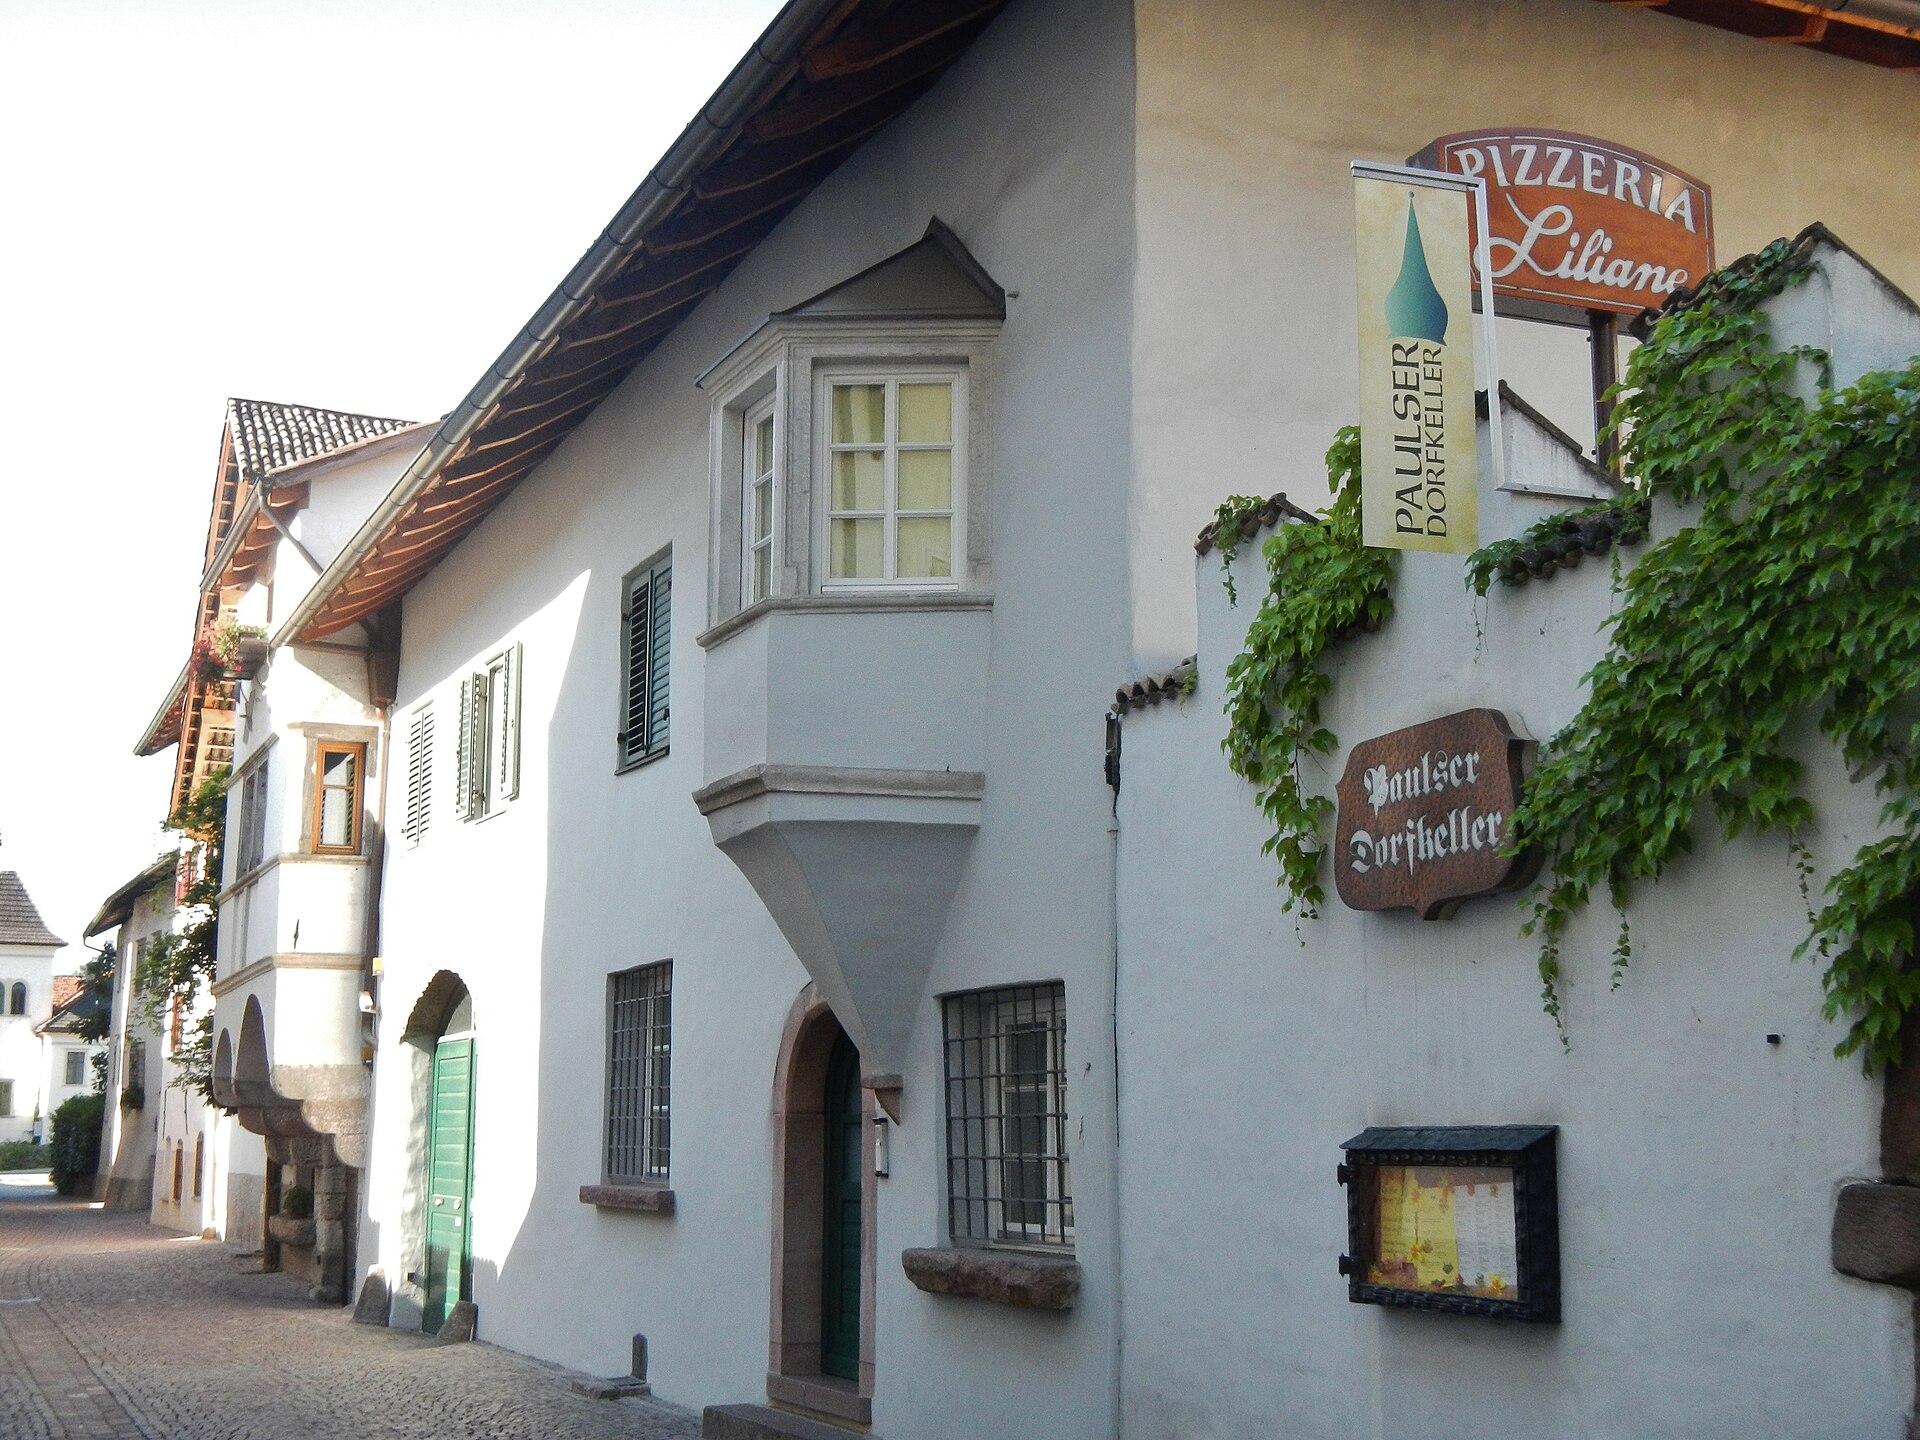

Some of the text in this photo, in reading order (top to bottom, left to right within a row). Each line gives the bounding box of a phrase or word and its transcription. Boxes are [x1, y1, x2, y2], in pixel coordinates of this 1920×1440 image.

[1454, 144, 1696, 234] PIZZERIA
[1472, 192, 1688, 295] Liliane
[1391, 341, 1424, 536] PAULSER
[1421, 346, 1447, 538] DORFKELLER
[1363, 750, 1479, 820] Paulser
[1350, 805, 1502, 876] Dorfkeller
